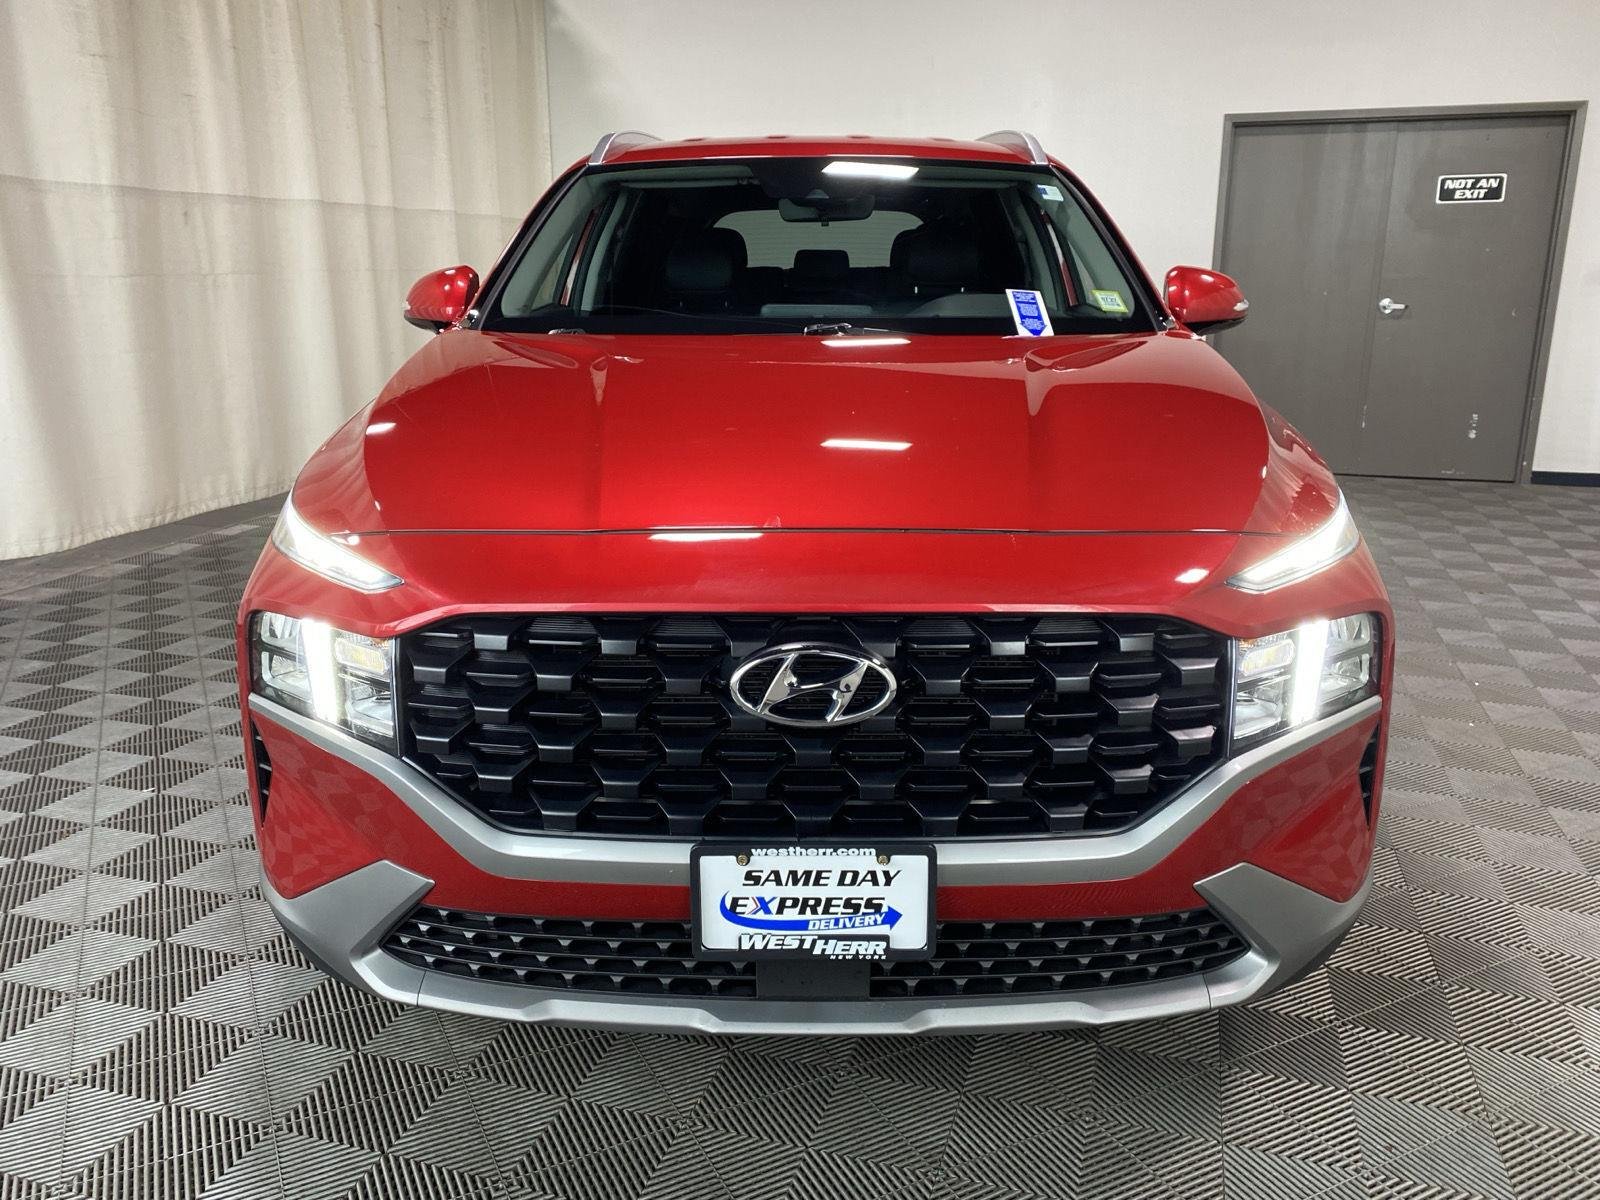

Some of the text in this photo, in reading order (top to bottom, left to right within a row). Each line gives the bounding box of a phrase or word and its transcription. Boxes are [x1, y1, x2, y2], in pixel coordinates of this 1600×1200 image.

[1444, 178, 1500, 189] NOT AN
[1454, 188, 1488, 199] EXIT
[751, 847, 876, 857] westherr.com
[742, 870, 902, 887] SAME DAY
[728, 896, 886, 915] EXPRESS
[808, 912, 886, 931] DELIVERY
